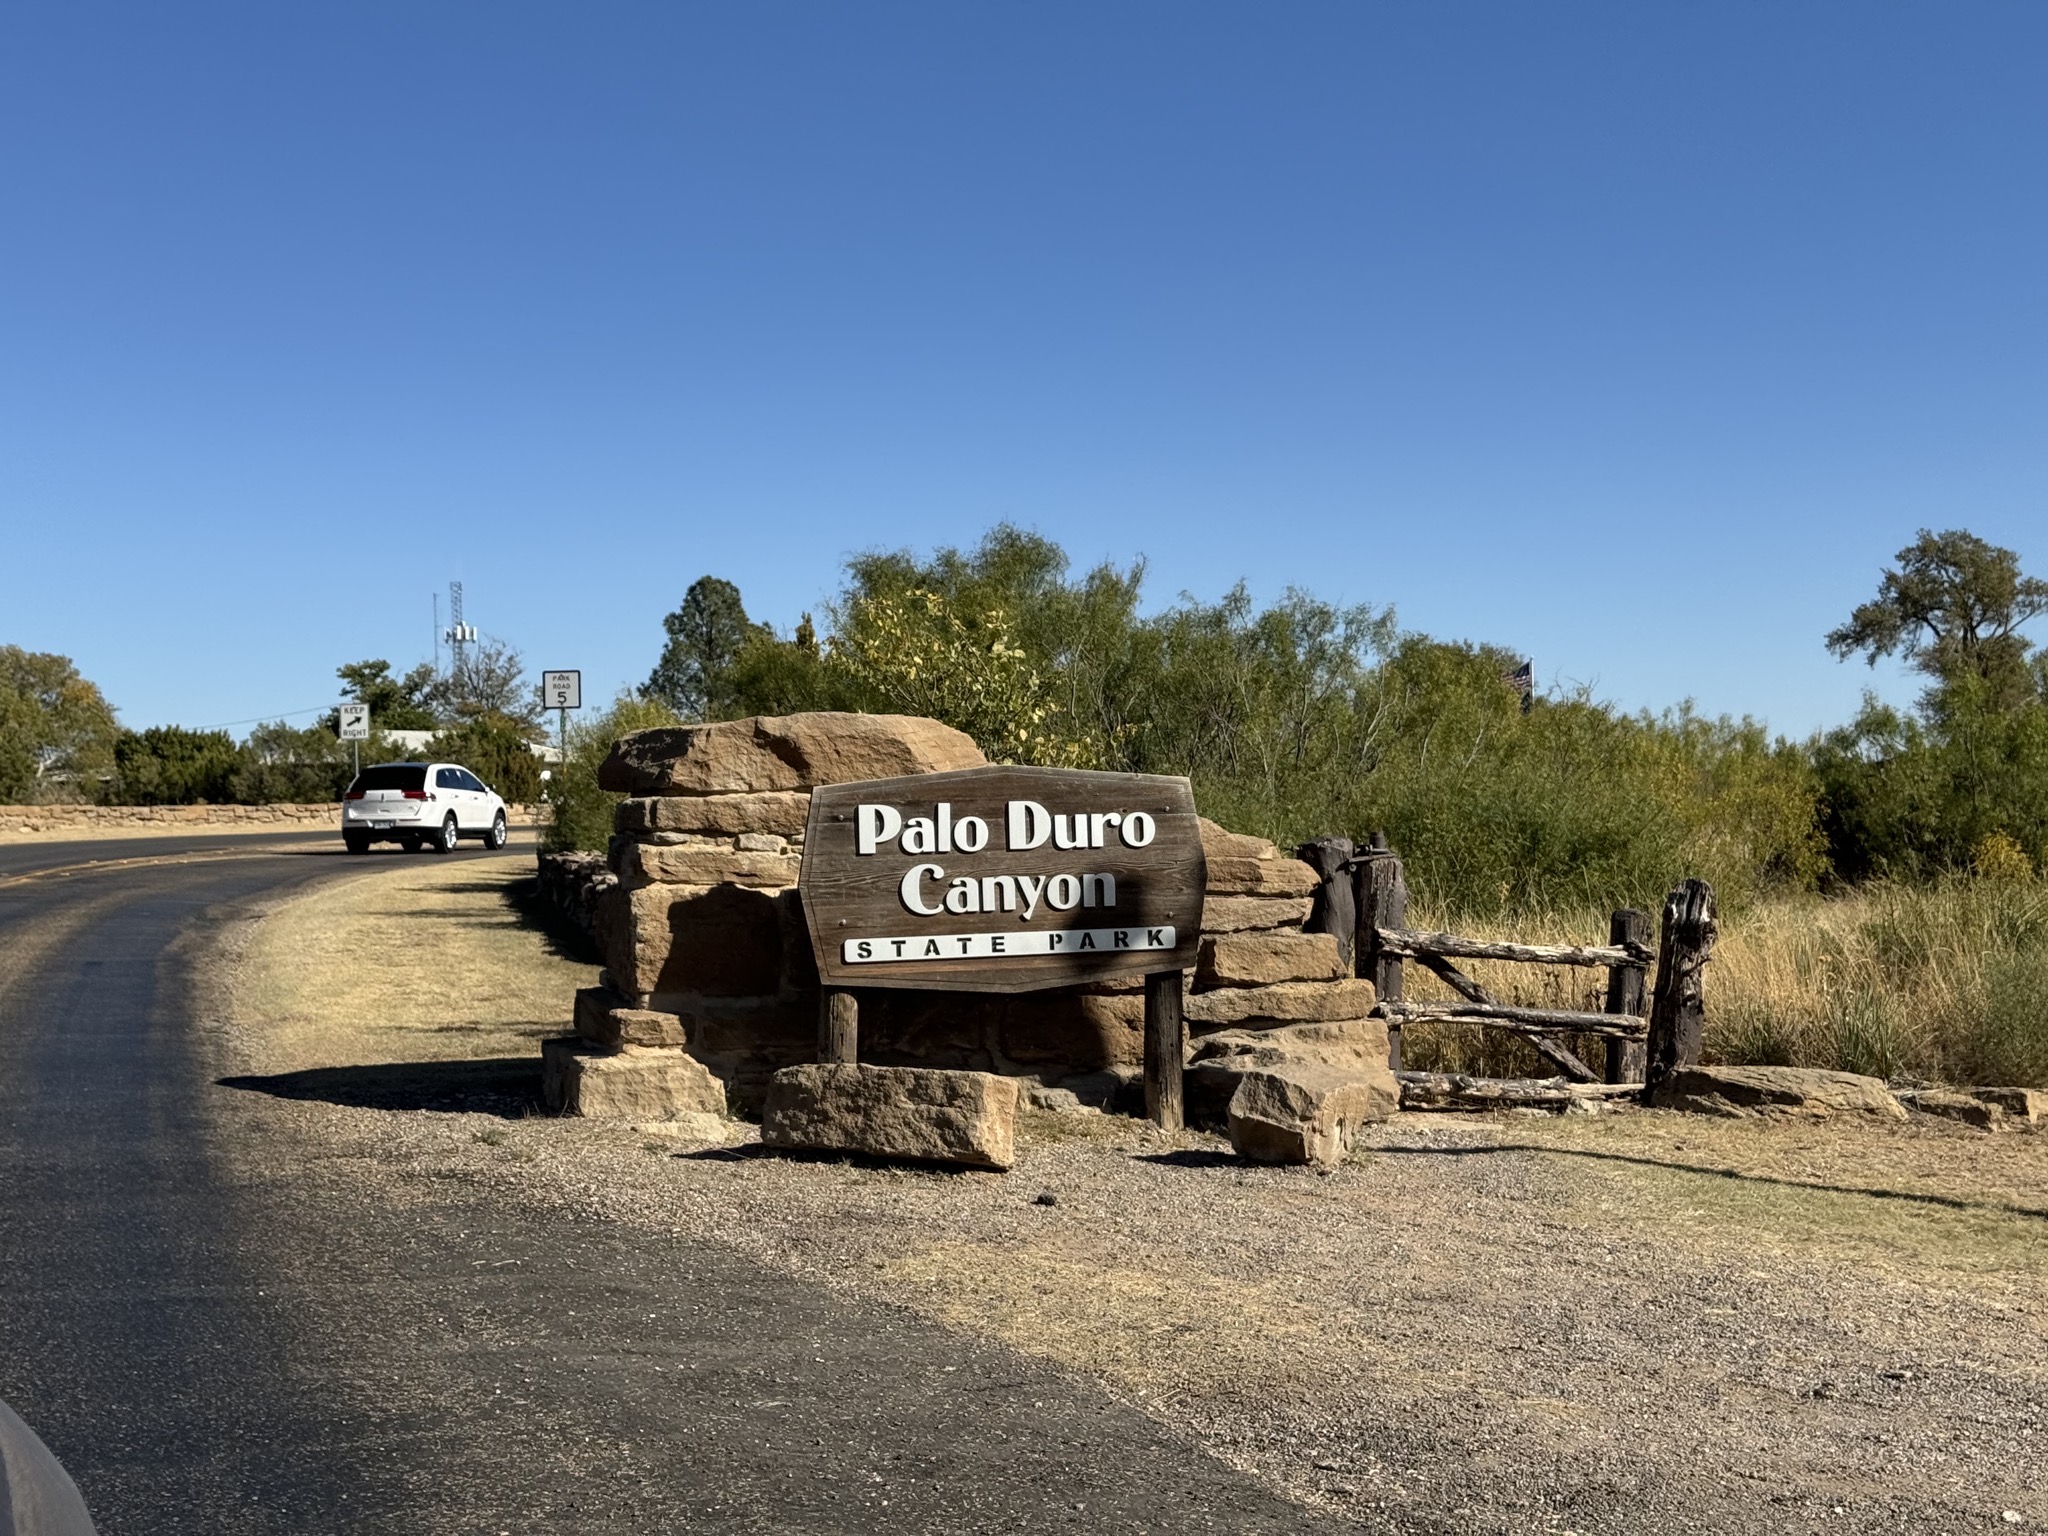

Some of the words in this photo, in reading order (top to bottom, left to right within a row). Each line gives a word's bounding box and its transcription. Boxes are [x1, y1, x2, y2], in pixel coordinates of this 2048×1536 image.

[552, 674, 571, 682] PARK
[557, 691, 567, 704] 5
[344, 706, 365, 714] KEEP
[343, 729, 367, 737] RIGHT
[857, 802, 989, 855] Palo
[1007, 800, 1156, 851] Duro
[900, 863, 1116, 921] Canyon
[856, 935, 1006, 959] STATE
[1048, 928, 1164, 951] PARK
